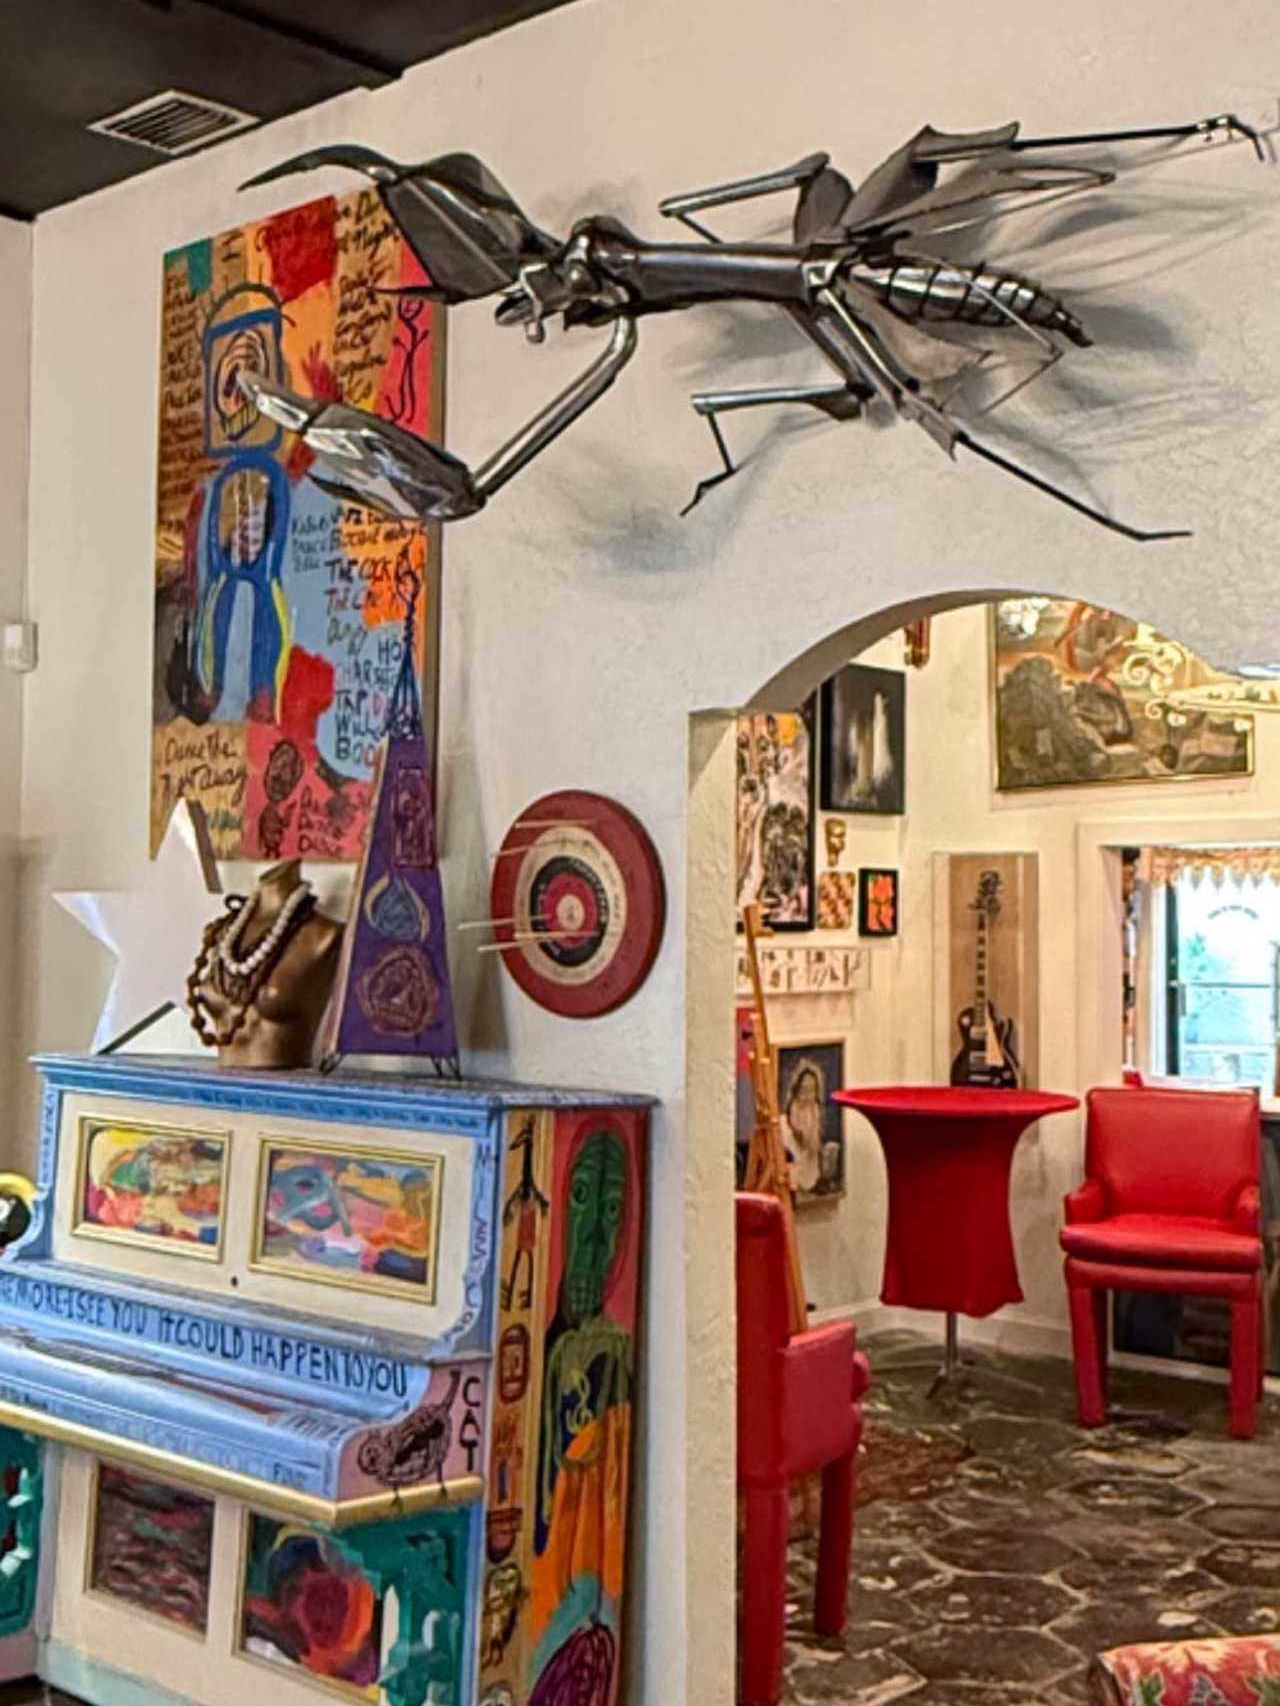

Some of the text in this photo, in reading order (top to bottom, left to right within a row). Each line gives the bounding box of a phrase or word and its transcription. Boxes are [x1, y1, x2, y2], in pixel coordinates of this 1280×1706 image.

[109, 1296, 148, 1336] YOU
[175, 1317, 245, 1362] COULD
[249, 1331, 342, 1385] HAPPEN
[365, 1356, 408, 1398] YOU
[460, 1375, 482, 1473] CAT
